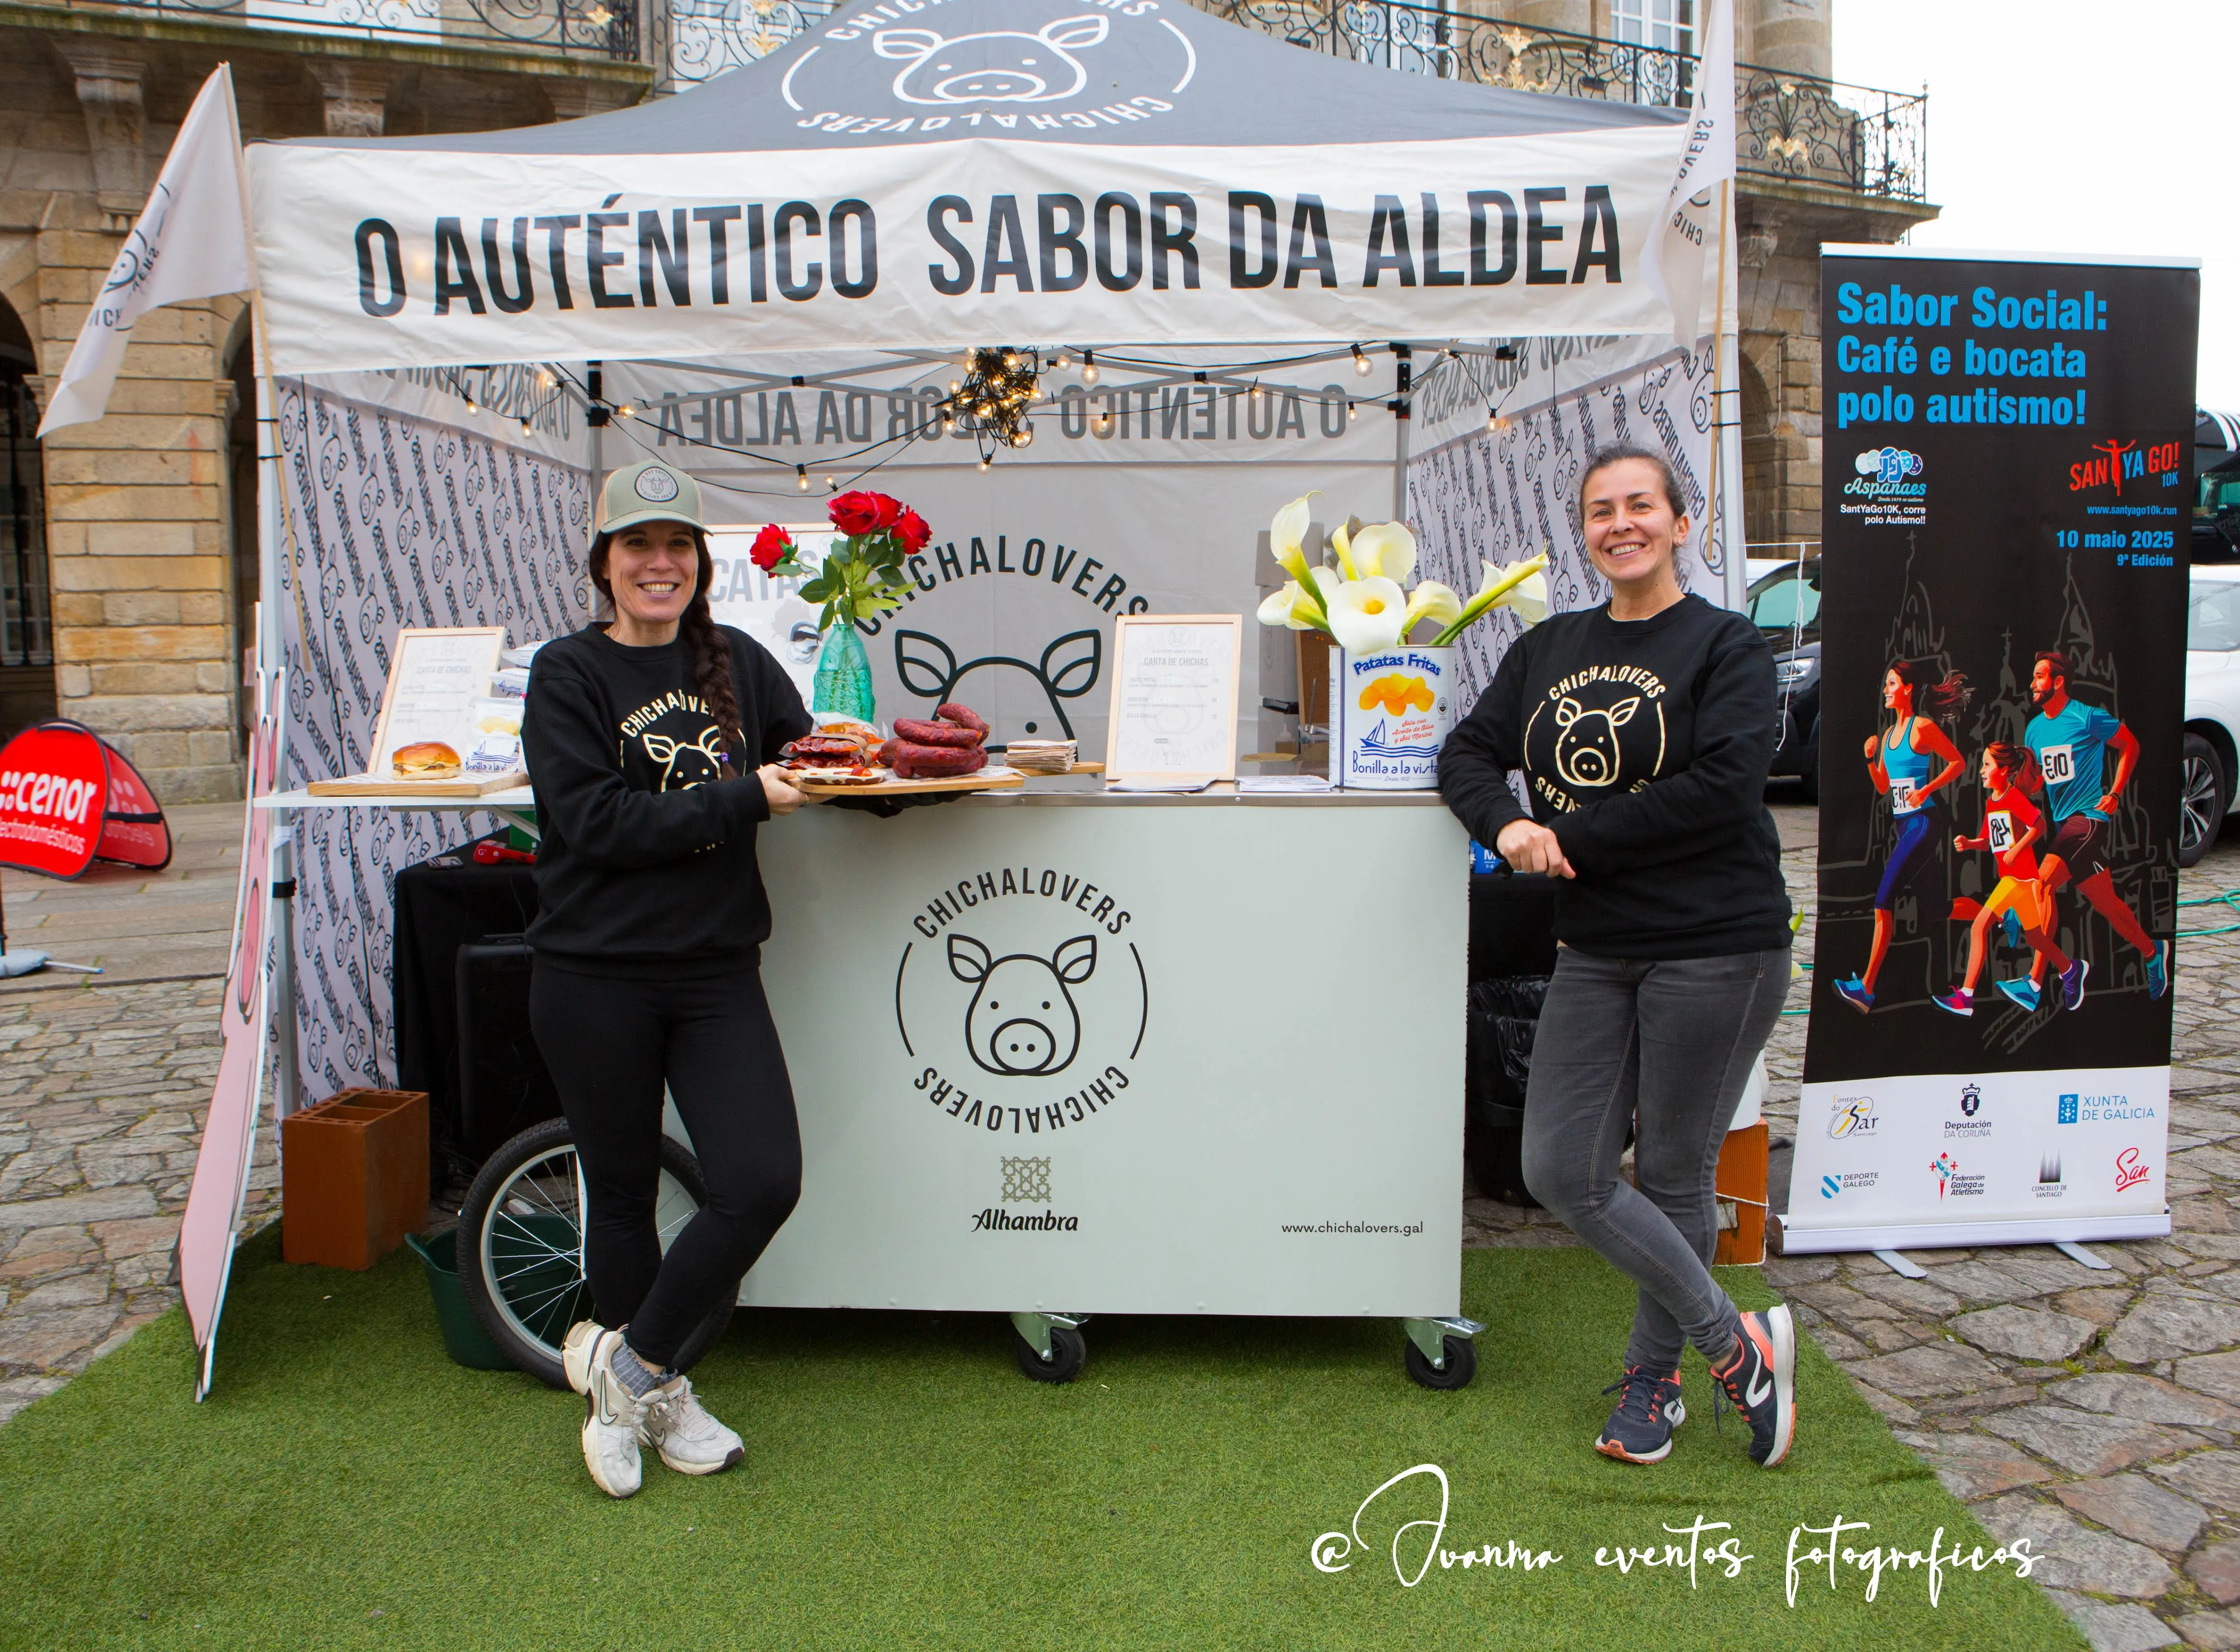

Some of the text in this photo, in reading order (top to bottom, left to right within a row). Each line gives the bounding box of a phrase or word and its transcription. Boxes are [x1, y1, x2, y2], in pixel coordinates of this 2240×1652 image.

[797, 96, 1174, 134] CHICHALOVERS
[355, 185, 1622, 317] O AUTÉNTICO SABOR DA ALDEA
[1837, 282, 2108, 330] Sabor Social:
[1837, 335, 2086, 378] Café e bocata
[1838, 385, 2086, 429] polo autismo!
[2162, 471, 2178, 487] 10K
[1844, 477, 1926, 500] Aspanaes
[1840, 504, 1901, 515] SantYaGo10K,
[2087, 505, 2177, 517] www.santyago10k.run
[1865, 515, 1926, 525] polo Autismo!!
[2056, 530, 2174, 549] 10 maio 2025
[2132, 554, 2173, 566] Edición
[1144, 657, 1209, 666] CARTA DE CHICHAS
[1353, 653, 1441, 677] Patatas Fritas
[1549, 665, 1666, 701] CHICHALOVERS
[1353, 750, 1389, 773] Bonilla
[1400, 760, 1410, 774] la
[16, 771, 97, 824] cenor
[913, 867, 1131, 938] CHICHALOVERS
[914, 1066, 1129, 1134] CHICHALOVERS
[1833, 1094, 1857, 1103] Fontes
[2083, 1096, 2128, 1107] XUNTA
[2082, 1108, 2155, 1121] DE GALICIA
[1944, 1128, 1991, 1138] DA CORUÑA
[1945, 1120, 1992, 1131] Deputación
[1843, 1180, 1875, 1188] GALEGO
[1844, 1172, 1879, 1181] DEPORTE
[1951, 1173, 1985, 1182] Federación
[1950, 1188, 1984, 1196] Atletismo
[971, 1209, 1078, 1232] Alhambra
[1281, 1221, 1423, 1236] www.chichalovers.gal
